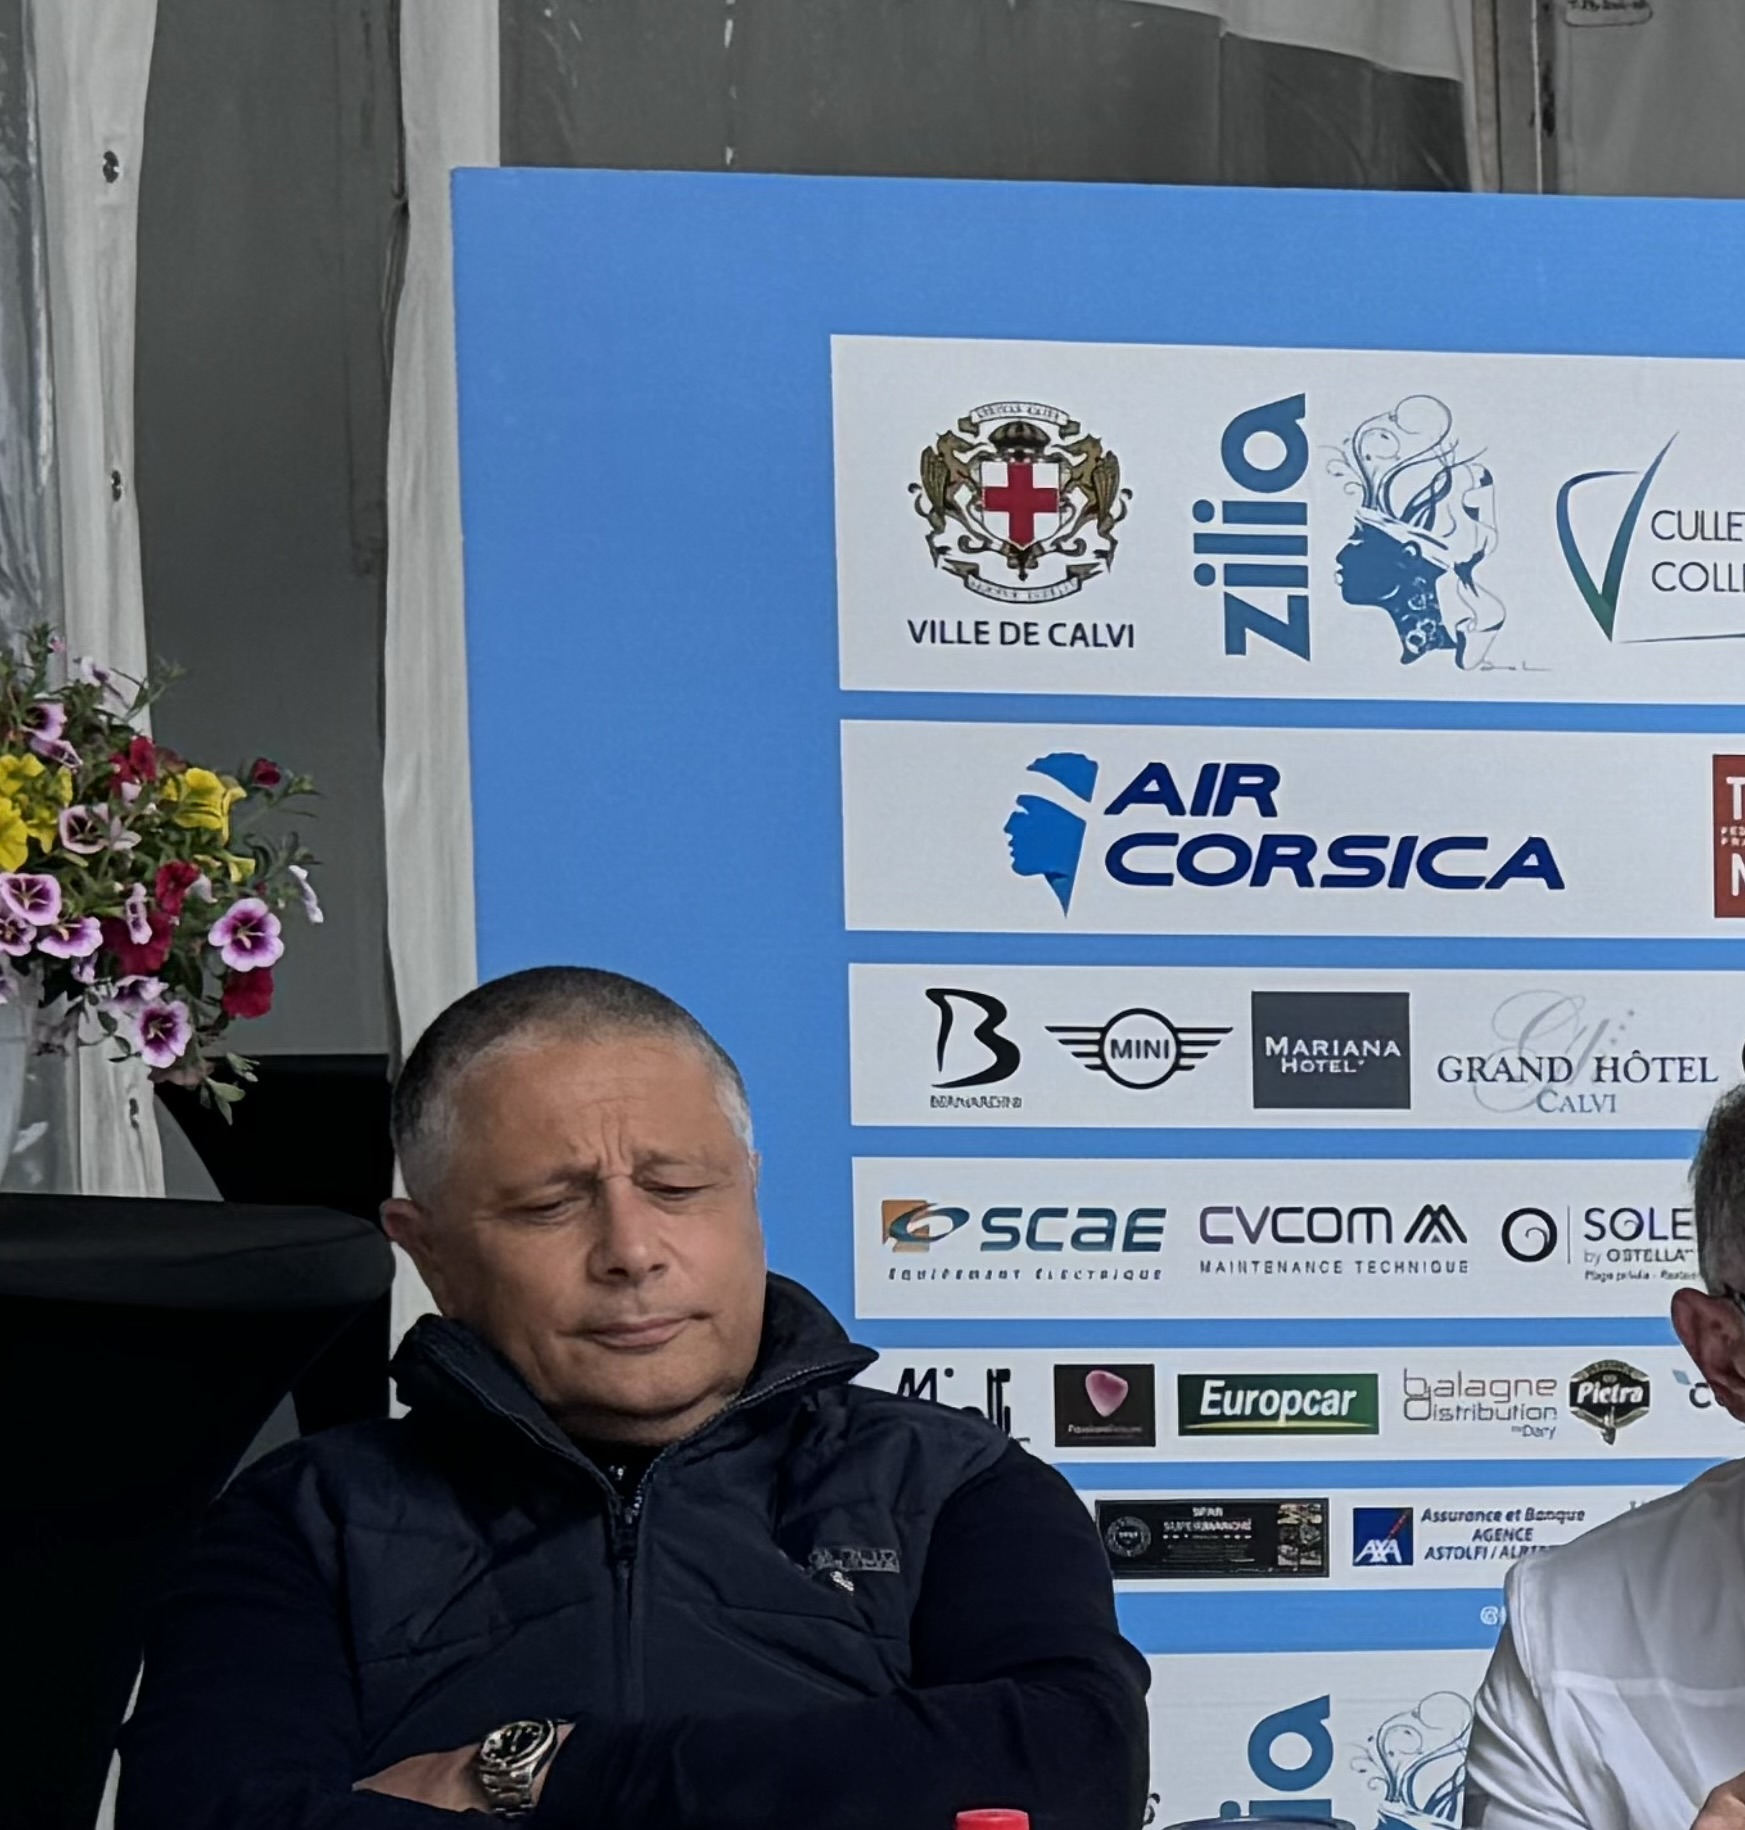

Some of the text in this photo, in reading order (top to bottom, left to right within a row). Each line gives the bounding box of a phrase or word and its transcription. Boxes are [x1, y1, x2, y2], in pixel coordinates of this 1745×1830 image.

[1192, 391, 1312, 663] zilia
[907, 618, 1135, 649] VILLE DE CALVI
[1103, 761, 1282, 818] AIR
[1104, 831, 1566, 891] CORSICA
[1110, 1038, 1171, 1061] MINI
[1264, 1036, 1402, 1058] MARIANA
[1280, 1058, 1359, 1075] HOTEL
[1437, 1049, 1719, 1084] GRAND HÔTEL
[1536, 1089, 1619, 1114] CALVI
[1199, 1205, 1394, 1246] CVCOM
[1199, 1259, 1469, 1276] MAINTENANCE TECHNIQUE
[1403, 1367, 1558, 1404] balagne
[1199, 1378, 1358, 1427] Europcar
[1403, 1383, 1558, 1422] distribution
[1420, 1507, 1504, 1525] Assurance
[1505, 1507, 1521, 1523] et
[1471, 1527, 1535, 1543] AGENCE
[1354, 1538, 1404, 1564] AXA
